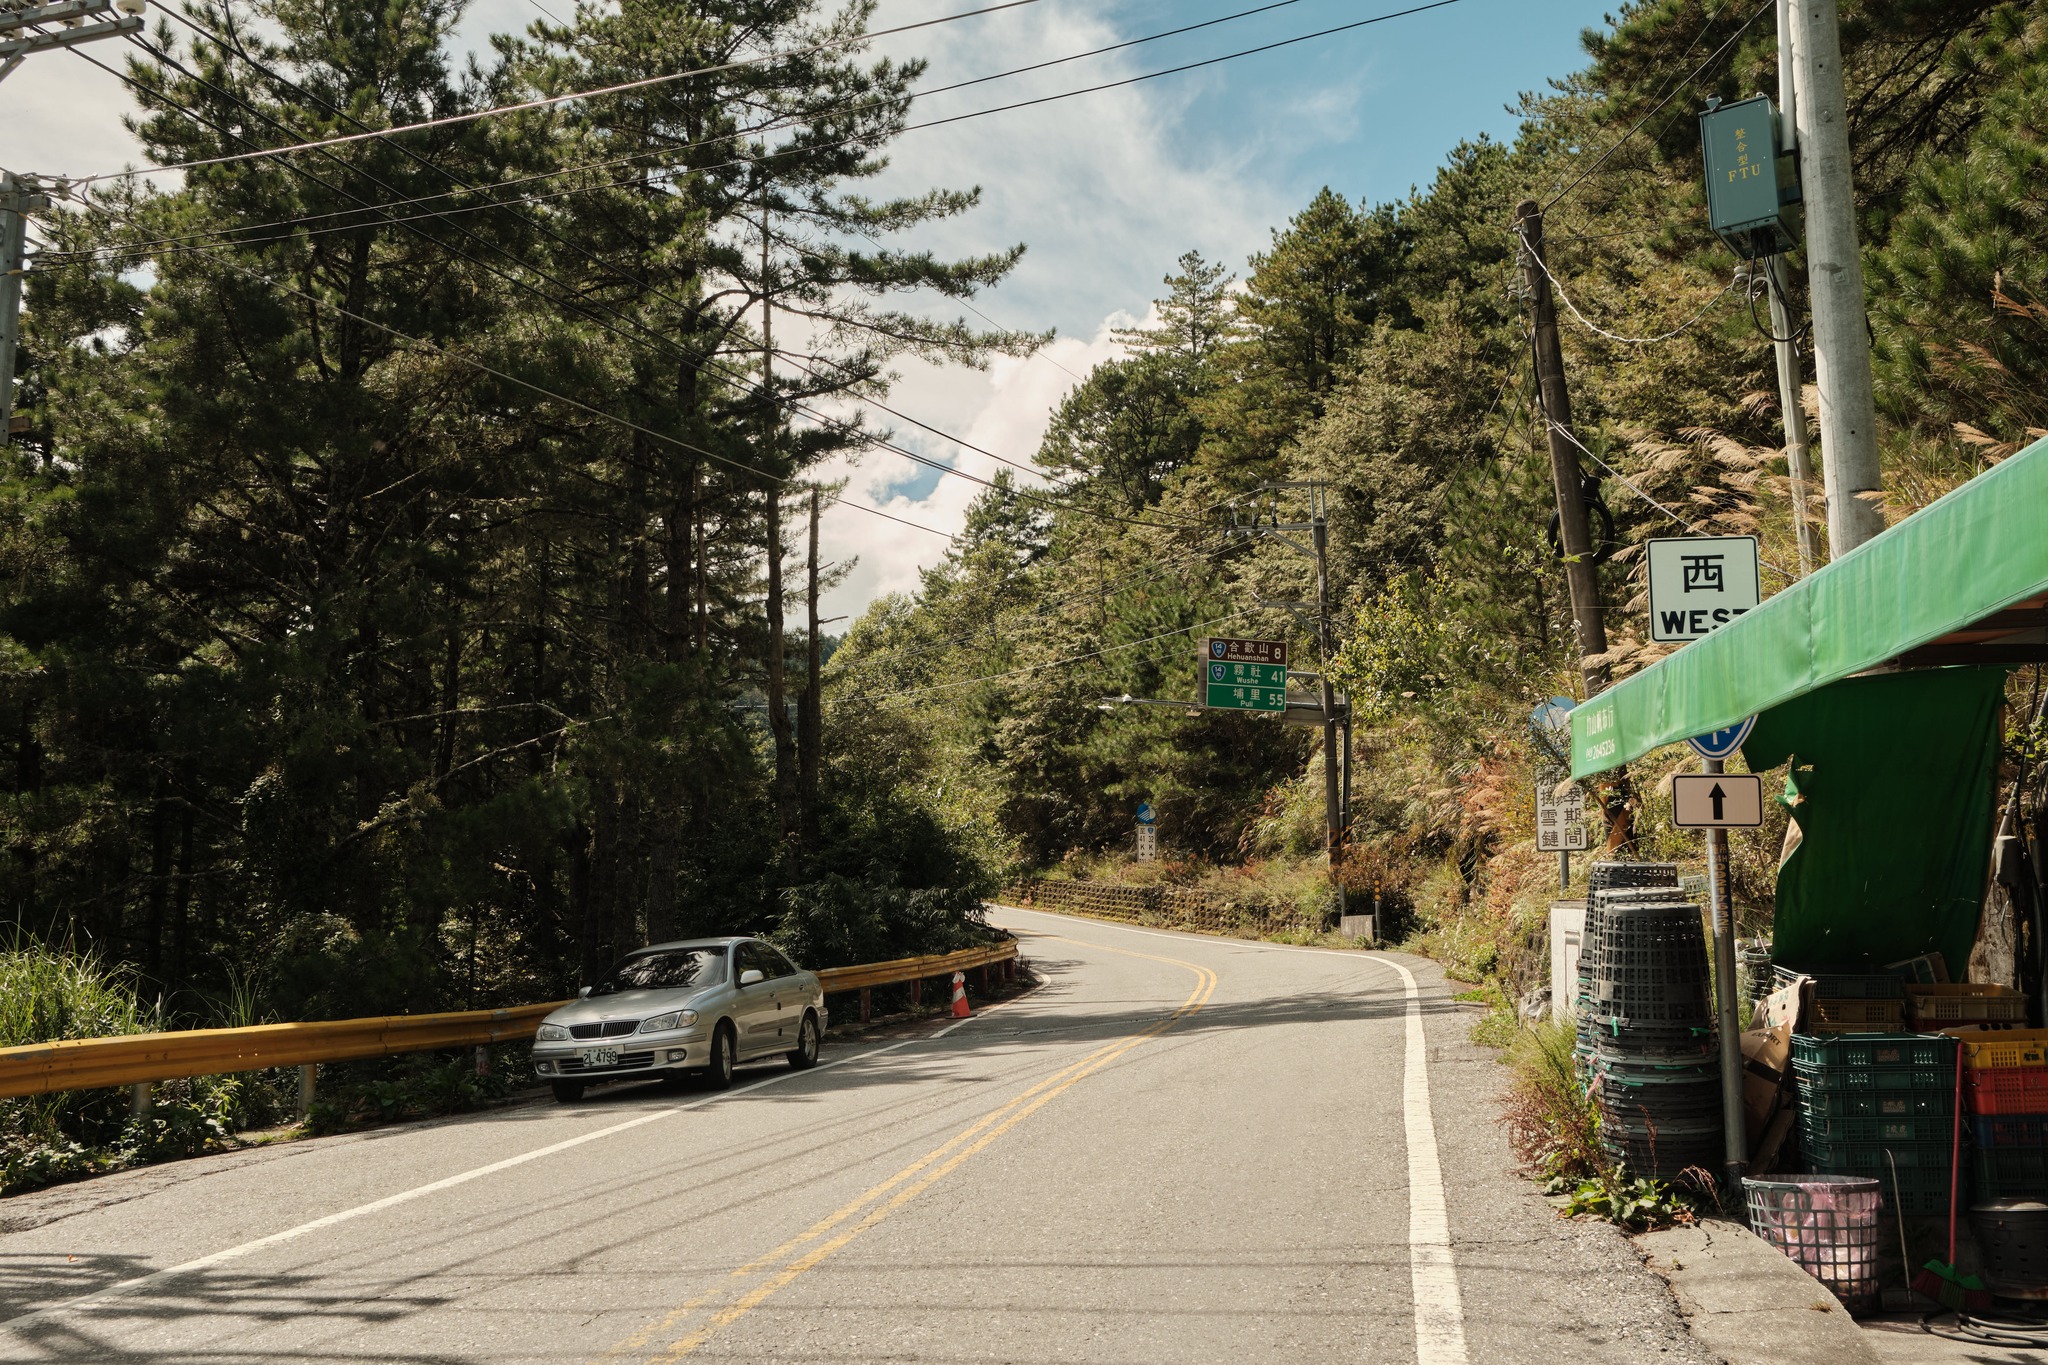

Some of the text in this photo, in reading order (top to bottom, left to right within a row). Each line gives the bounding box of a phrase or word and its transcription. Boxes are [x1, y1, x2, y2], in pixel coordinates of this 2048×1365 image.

[1735, 128, 1748, 166] 整合型
[1728, 164, 1760, 182] FTU
[1681, 555, 1724, 593] 西
[1229, 641, 1268, 654] 合歡山
[1274, 648, 1281, 660] 8
[1227, 653, 1269, 662] Hehuanshan
[1233, 664, 1261, 677] 霧社
[1271, 671, 1283, 683] 41
[1233, 687, 1260, 700] 埔里
[1269, 693, 1284, 706] 55
